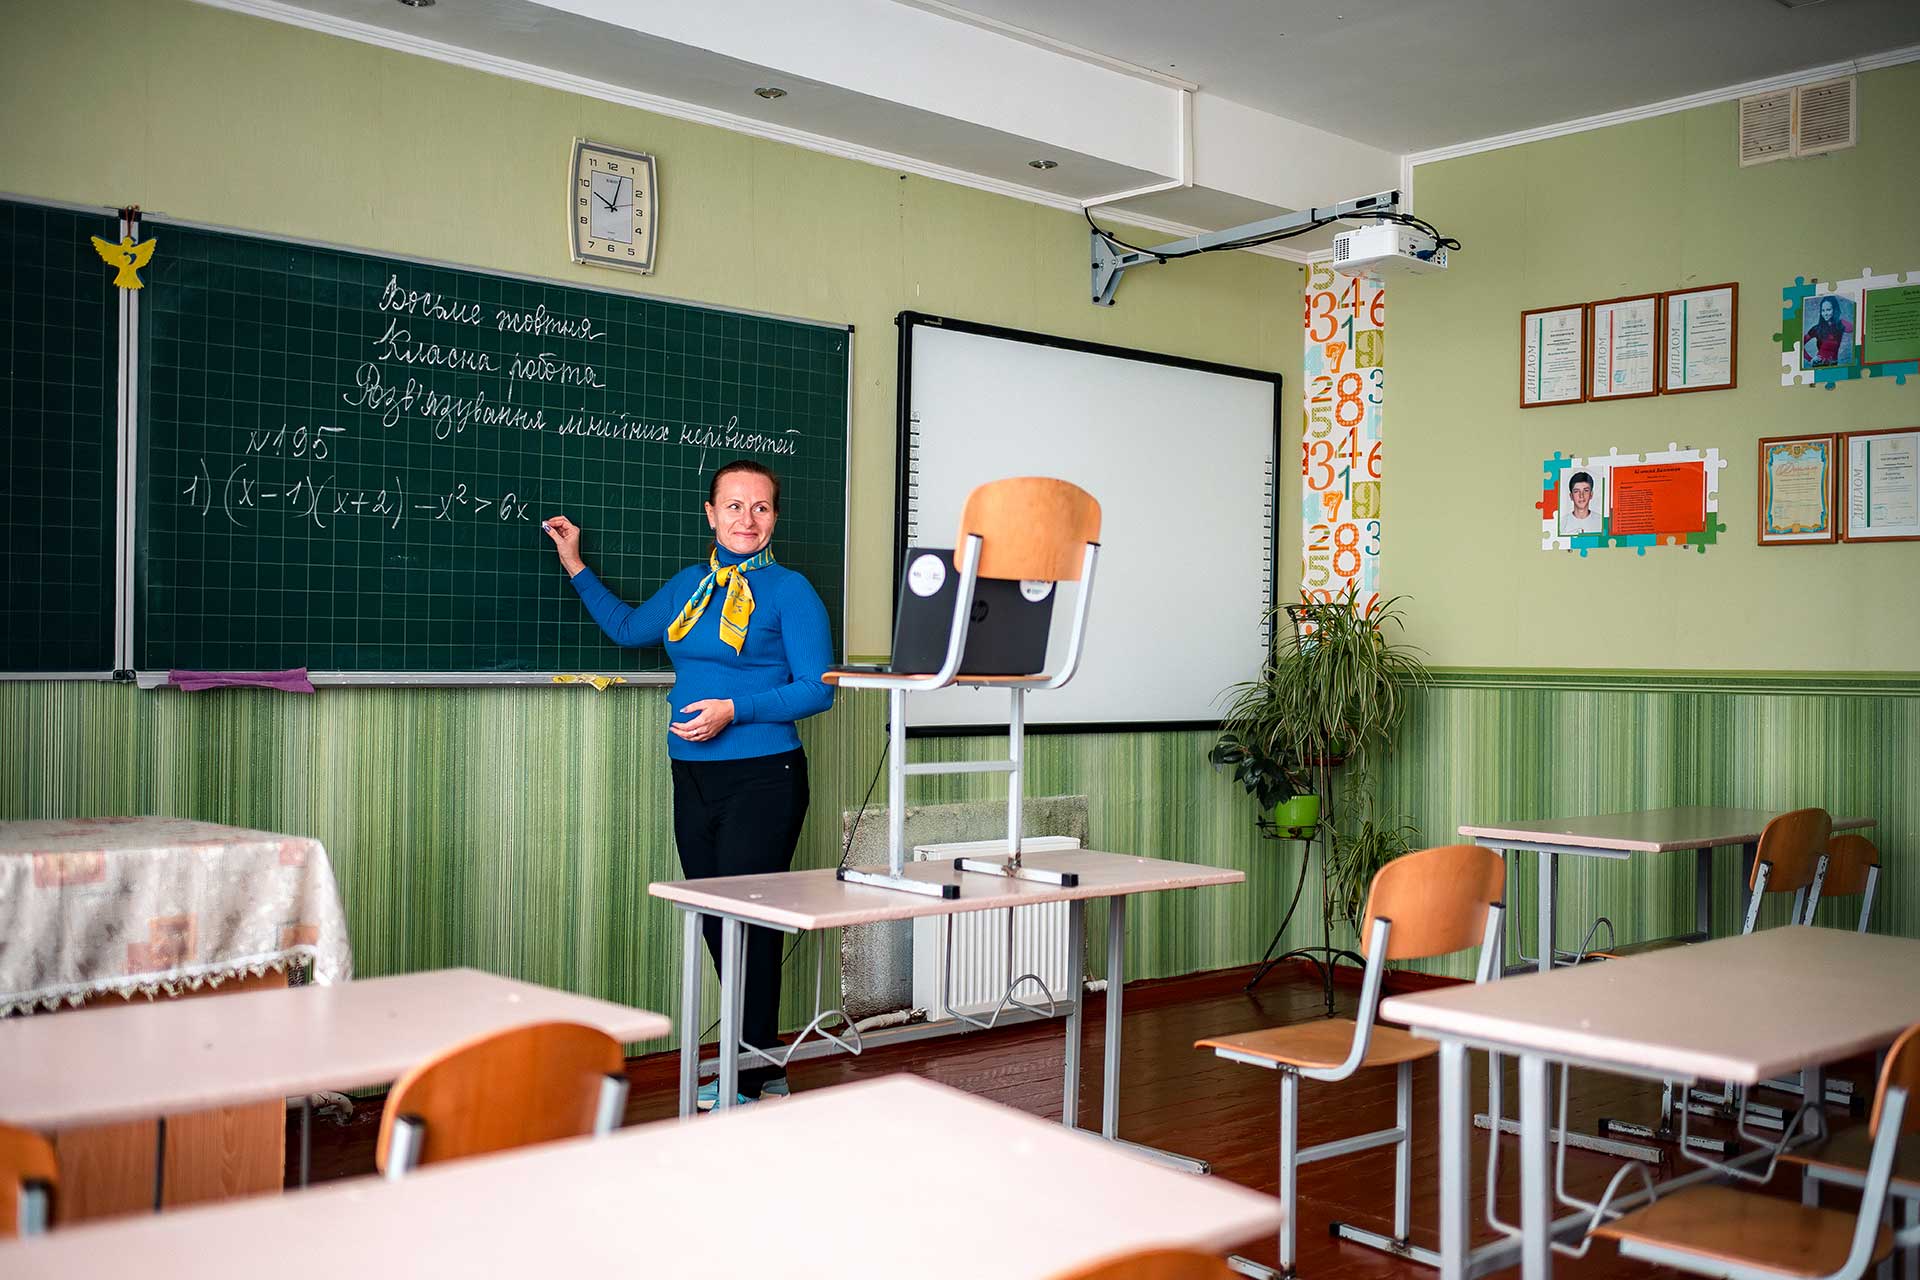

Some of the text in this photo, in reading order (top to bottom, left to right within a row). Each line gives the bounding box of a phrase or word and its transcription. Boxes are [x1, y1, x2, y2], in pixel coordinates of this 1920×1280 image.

[589, 158, 598, 167] 11
[607, 162, 618, 171] 12
[631, 167, 635, 175] 1
[579, 178, 590, 188] 10
[635, 190, 643, 198] 2
[580, 198, 588, 206] 9
[635, 209, 643, 217] 3
[580, 216, 588, 224] 8
[635, 227, 642, 235] 4
[588, 240, 595, 248] 7
[607, 244, 615, 252] 6
[627, 248, 635, 256] 5
[379, 273, 607, 341] Восьме жовтня
[1671, 327, 1681, 378] ДИПЛОМ
[373, 317, 606, 402] Класна робота
[1598, 337, 1608, 387] ДИПЛОМ
[1527, 345, 1537, 395] ДИПЛОМ
[558, 407, 670, 441] лінійних
[679, 415, 801, 476] нерівностей
[1853, 468, 1865, 520] ДИПЛОМ
